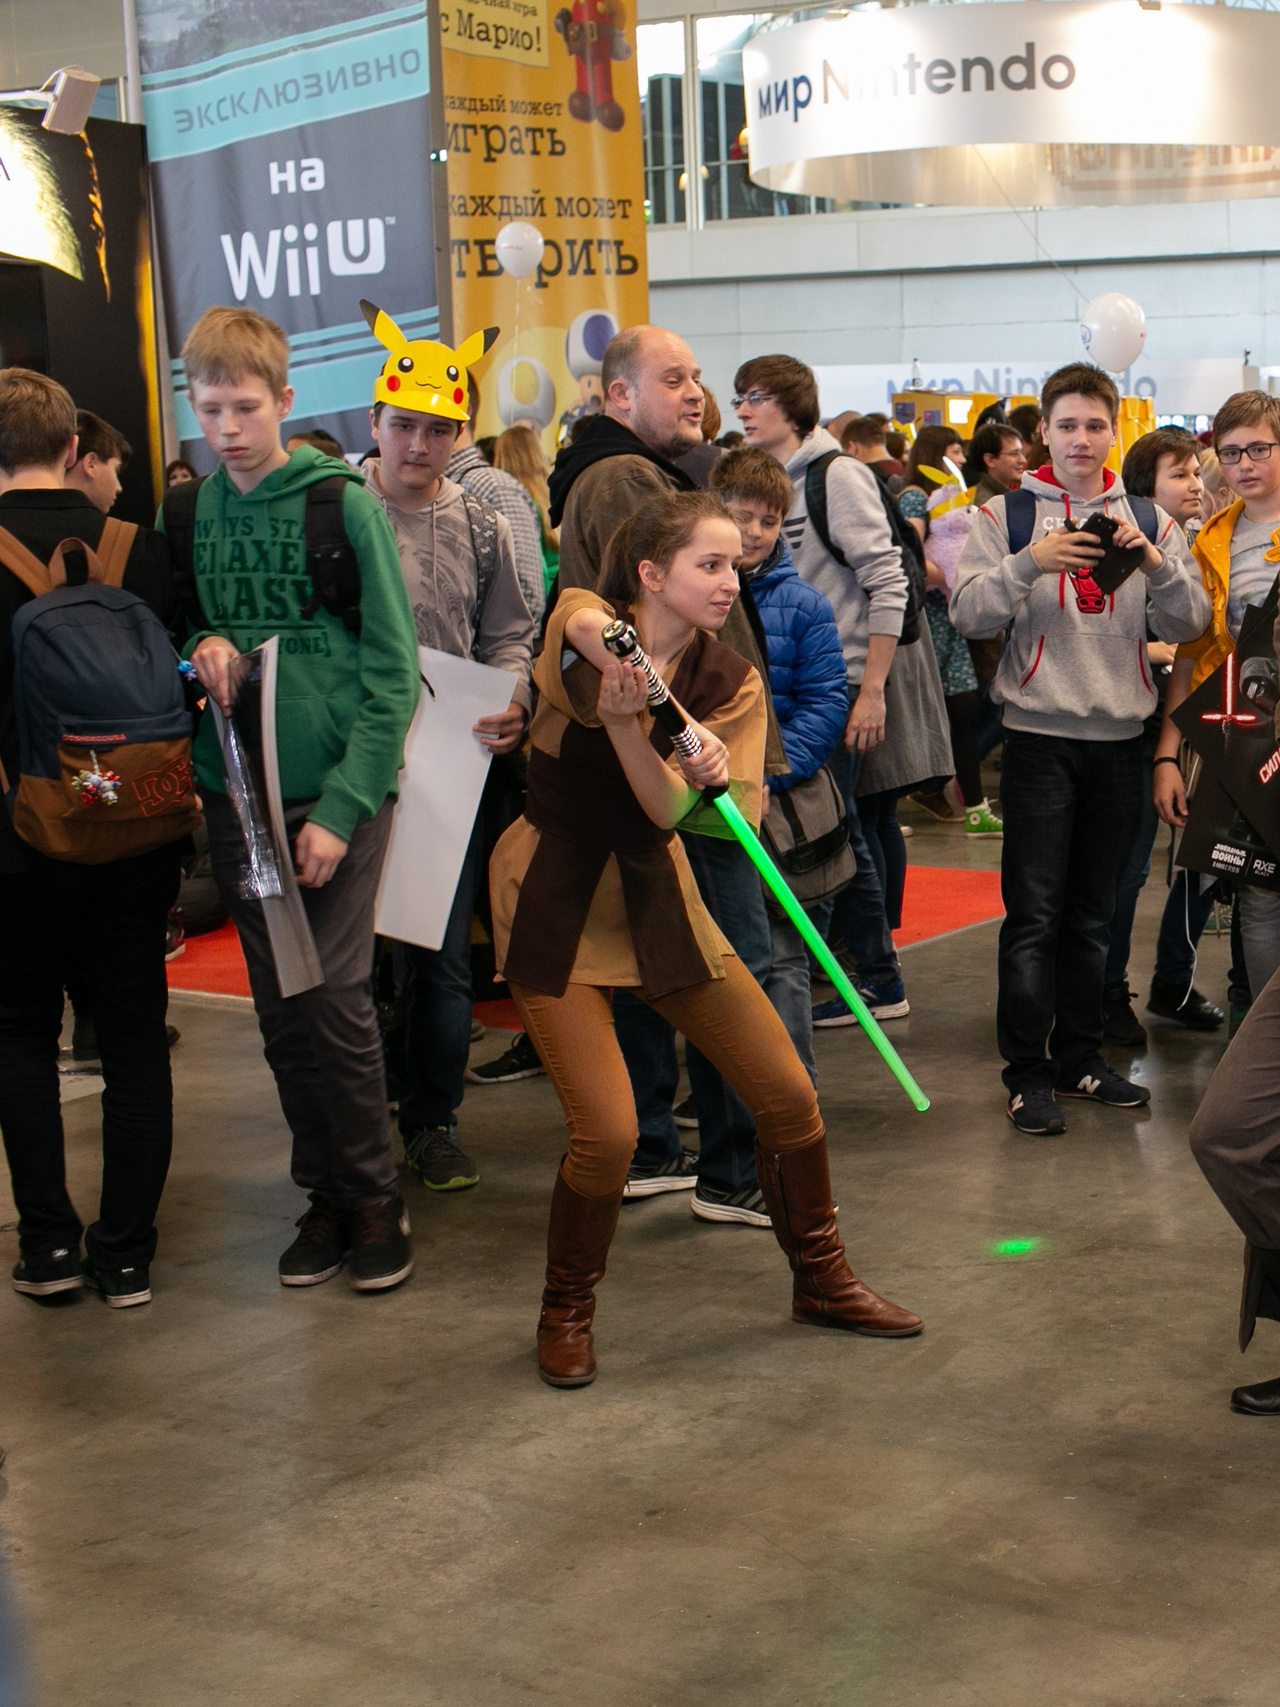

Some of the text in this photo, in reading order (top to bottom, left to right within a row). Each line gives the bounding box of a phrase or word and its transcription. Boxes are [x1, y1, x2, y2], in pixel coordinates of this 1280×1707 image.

[457, 8, 542, 52] Марио!
[173, 48, 421, 133] ЭКСКЛЮЗИВНО
[758, 42, 1076, 122] мир Nintendo
[445, 94, 563, 117] аждый может
[446, 121, 567, 162] играть
[268, 157, 325, 194] на
[556, 196, 632, 219] может
[219, 222, 321, 301] Wii
[326, 217, 386, 276] U
[451, 239, 639, 289] тврить
[1253, 859, 1276, 873] AXE
